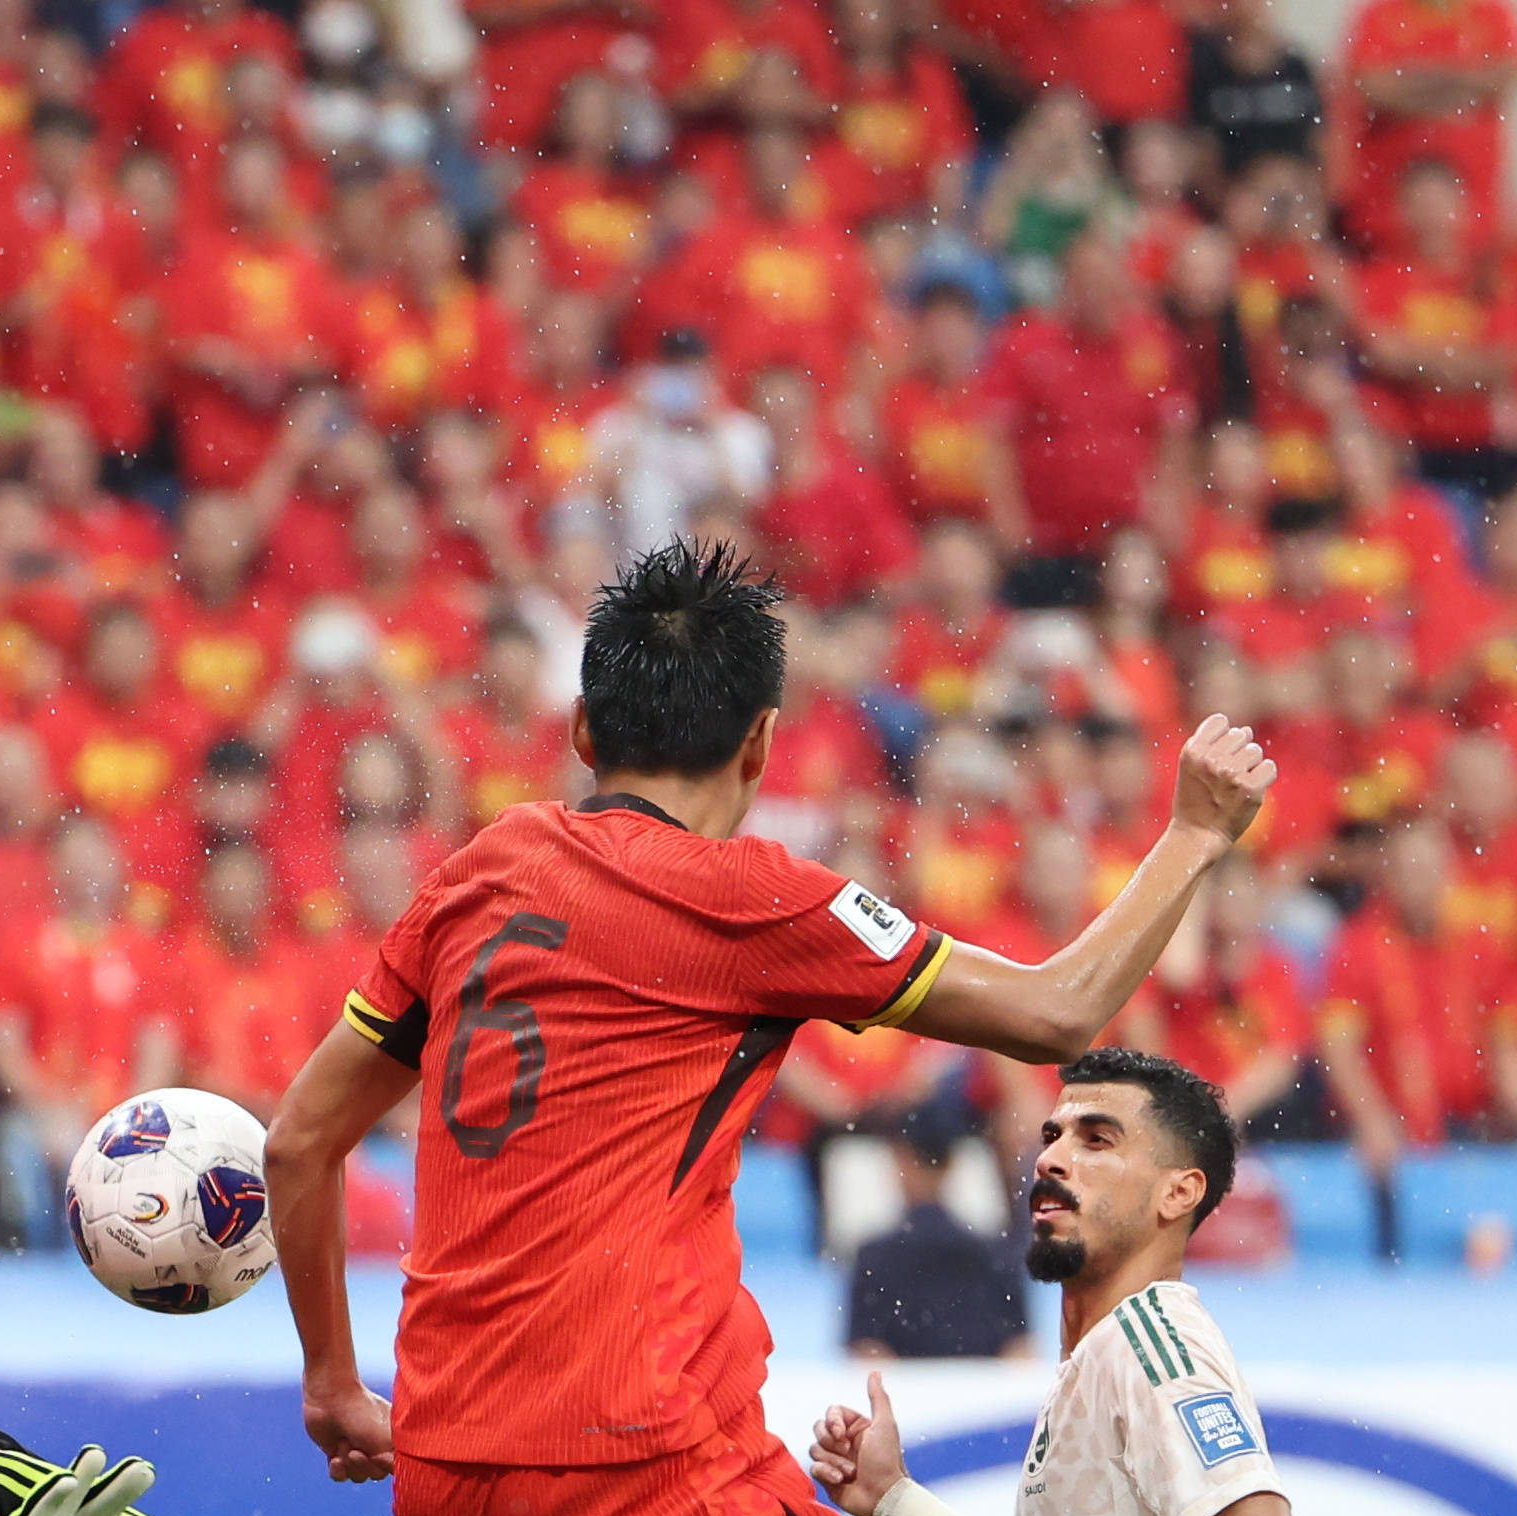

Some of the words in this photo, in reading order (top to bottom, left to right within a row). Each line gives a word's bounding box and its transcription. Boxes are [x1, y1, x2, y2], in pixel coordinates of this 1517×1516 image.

[442, 911, 570, 1160] 6
[1192, 1402, 1231, 1419] FOOTBALL
[1196, 1411, 1237, 1432] UNITES
[1025, 1482, 1046, 1498] SAUDI
